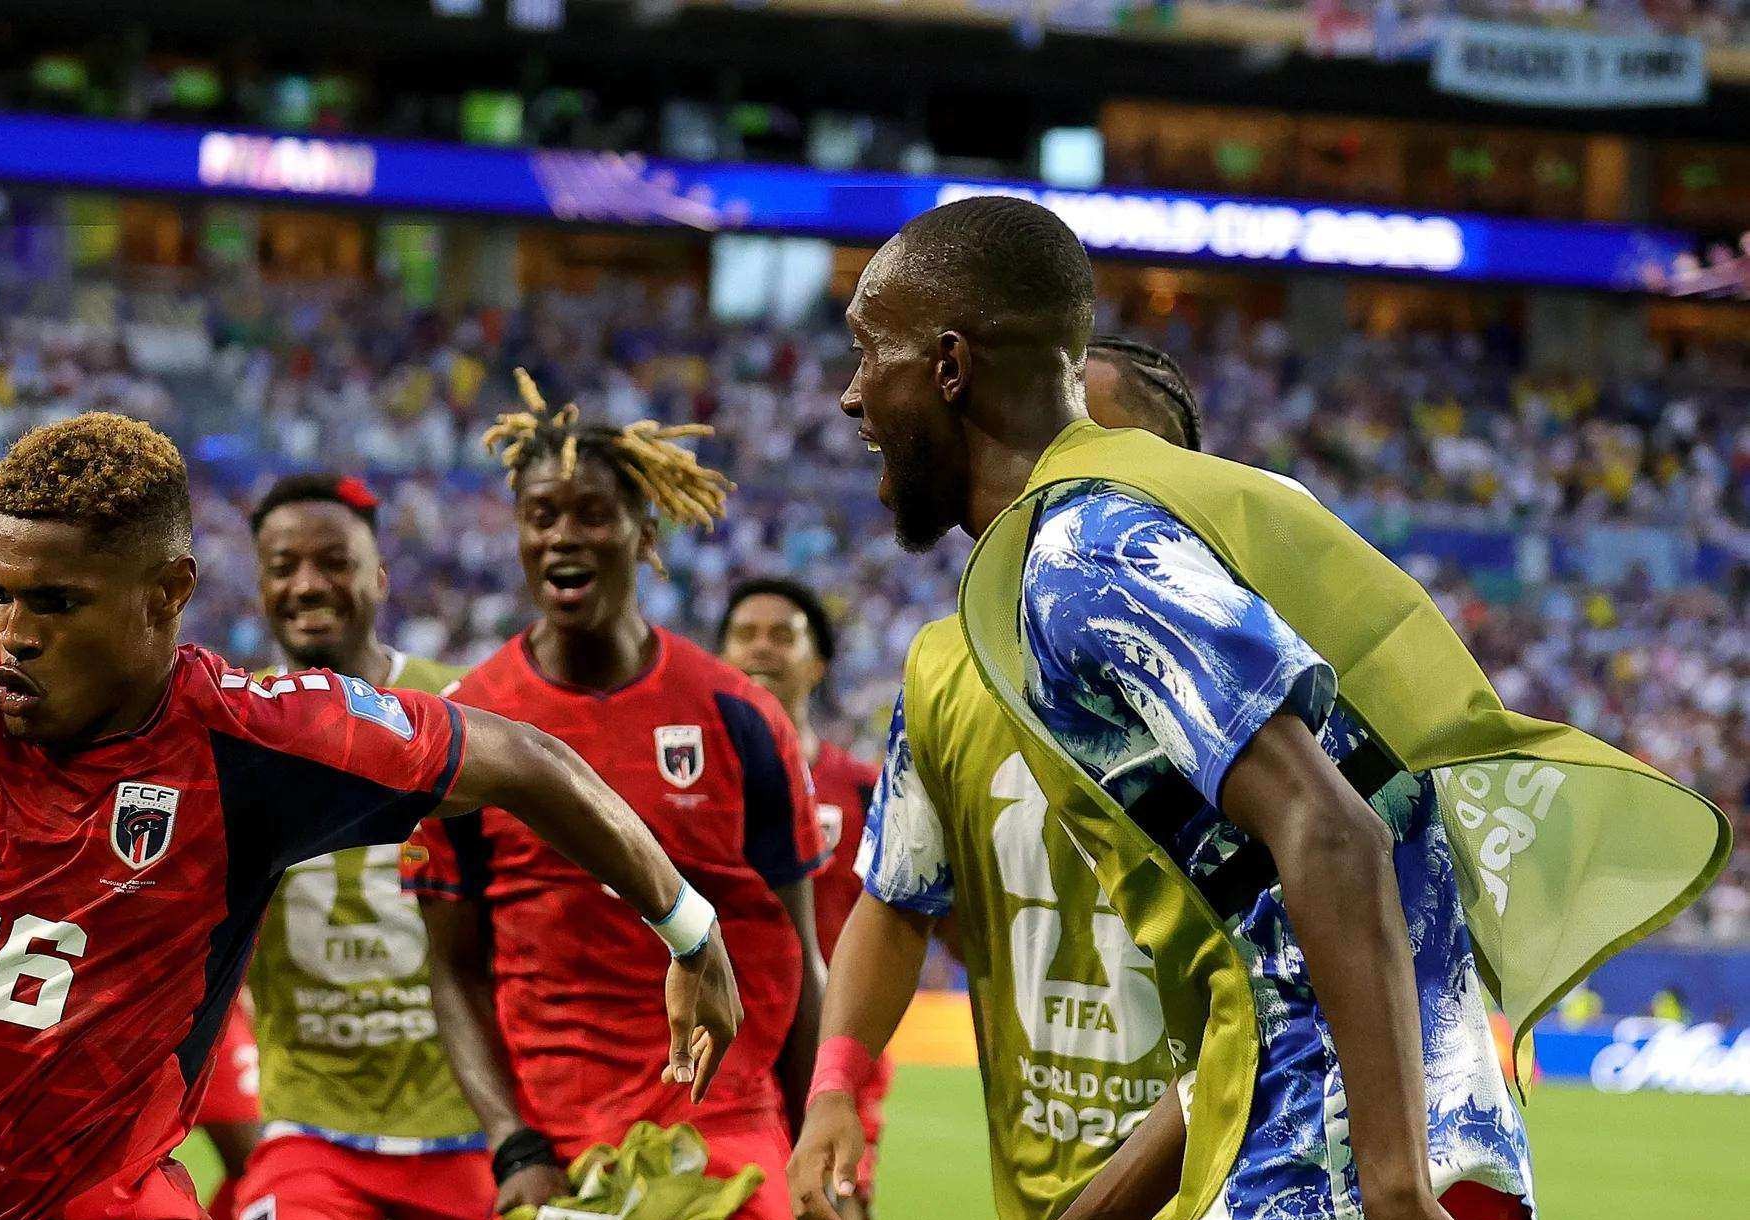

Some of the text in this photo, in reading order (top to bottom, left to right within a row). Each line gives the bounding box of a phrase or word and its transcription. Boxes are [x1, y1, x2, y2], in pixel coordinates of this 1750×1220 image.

[122, 786, 175, 802] FCF
[1044, 995, 1118, 1034] FIFA
[1104, 1076, 1168, 1104] CUP
